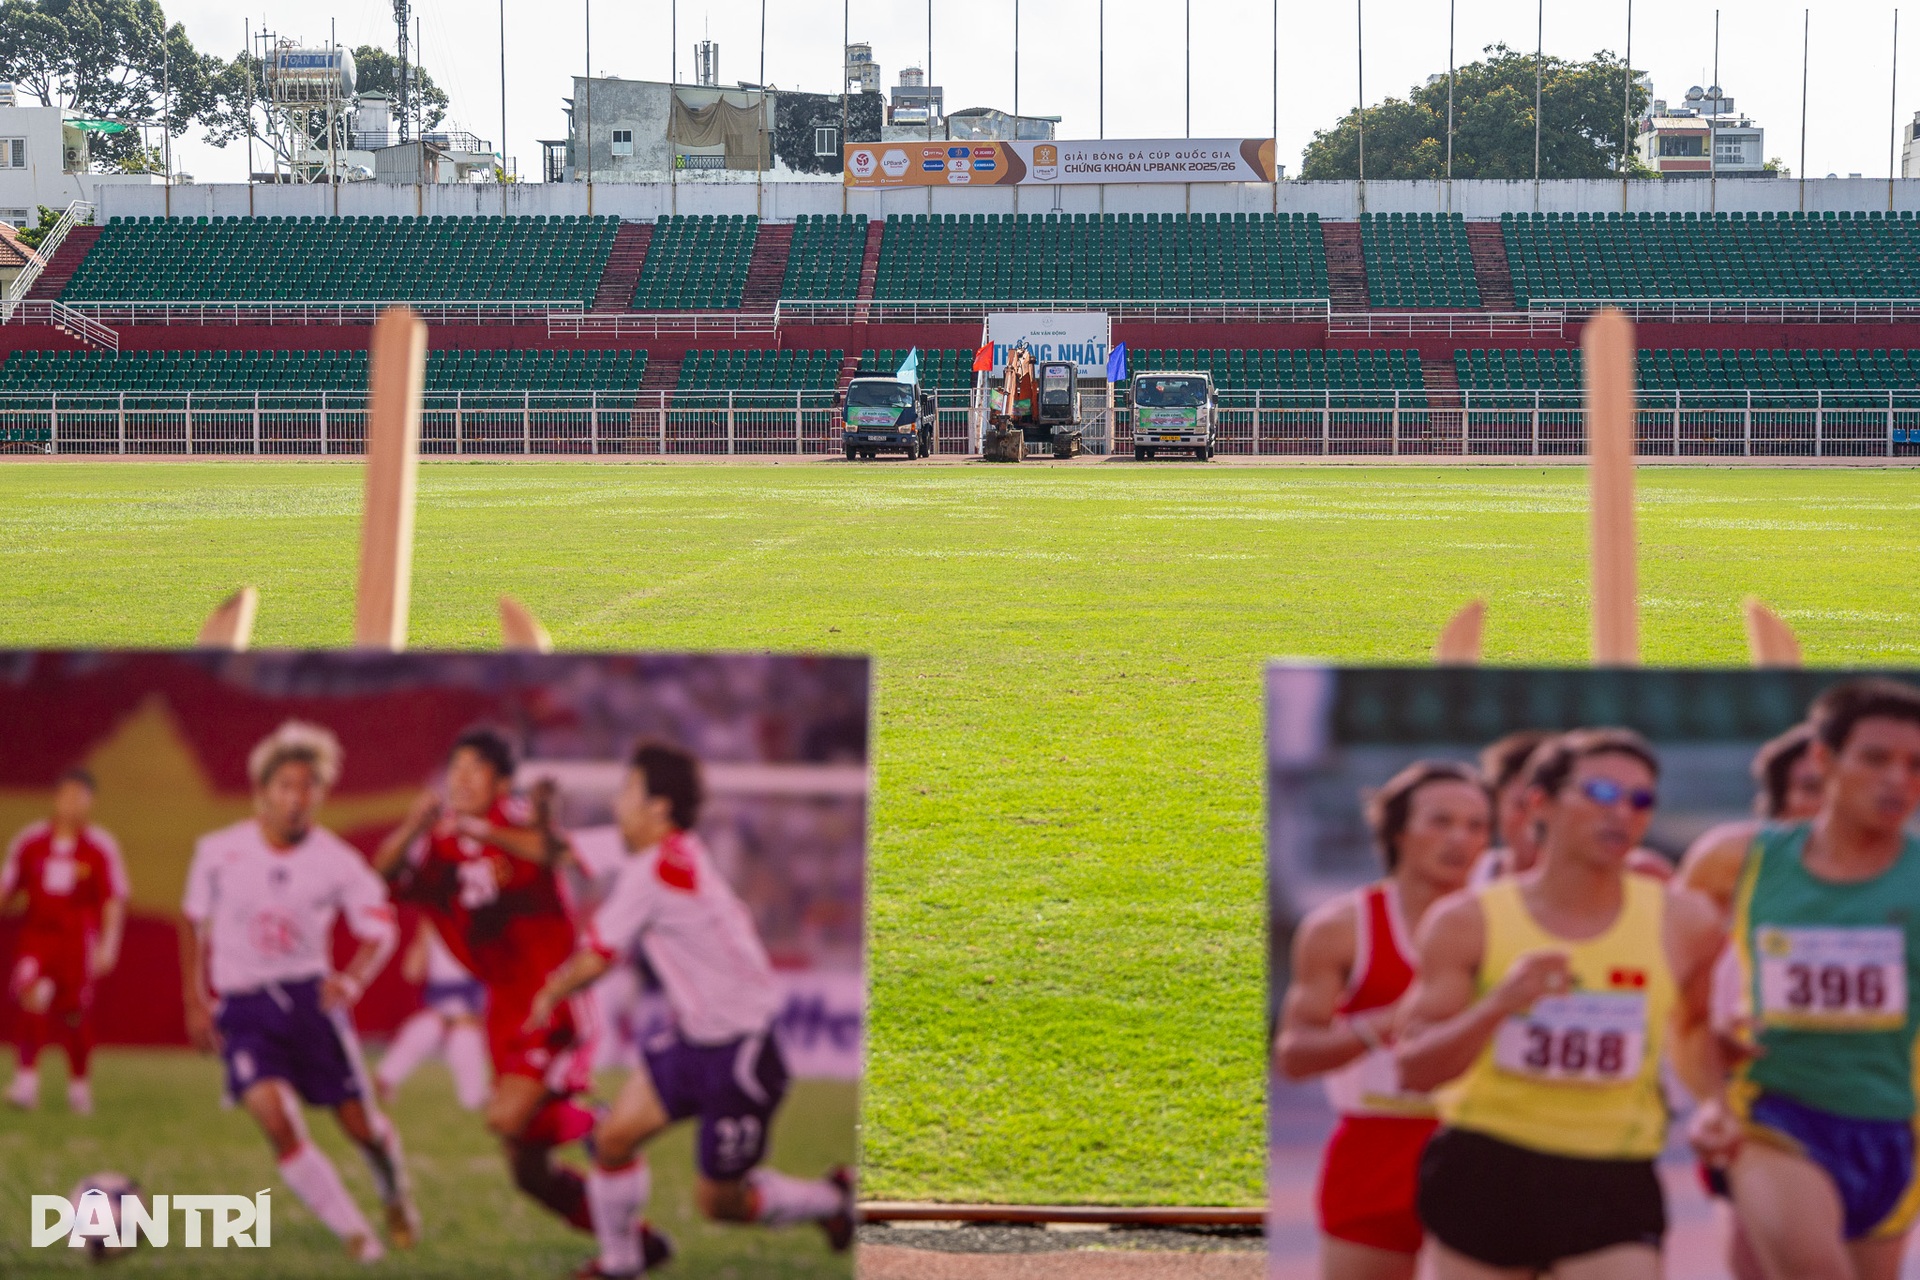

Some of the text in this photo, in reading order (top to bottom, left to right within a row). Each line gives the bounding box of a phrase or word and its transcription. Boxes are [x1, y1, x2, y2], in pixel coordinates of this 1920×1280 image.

[1064, 148, 1231, 161] GIẢI BÓNG ĐÁ CÚP QUỐC GIA
[1064, 161, 1102, 173] CHỨNG
[1104, 161, 1141, 172] KHOÁN
[1143, 162, 1186, 172] LPBANK
[1188, 162, 1236, 172] 2025/26
[1058, 335, 1107, 365] NHẤT
[1787, 963, 1885, 1009] 396
[1525, 1023, 1625, 1074] 368
